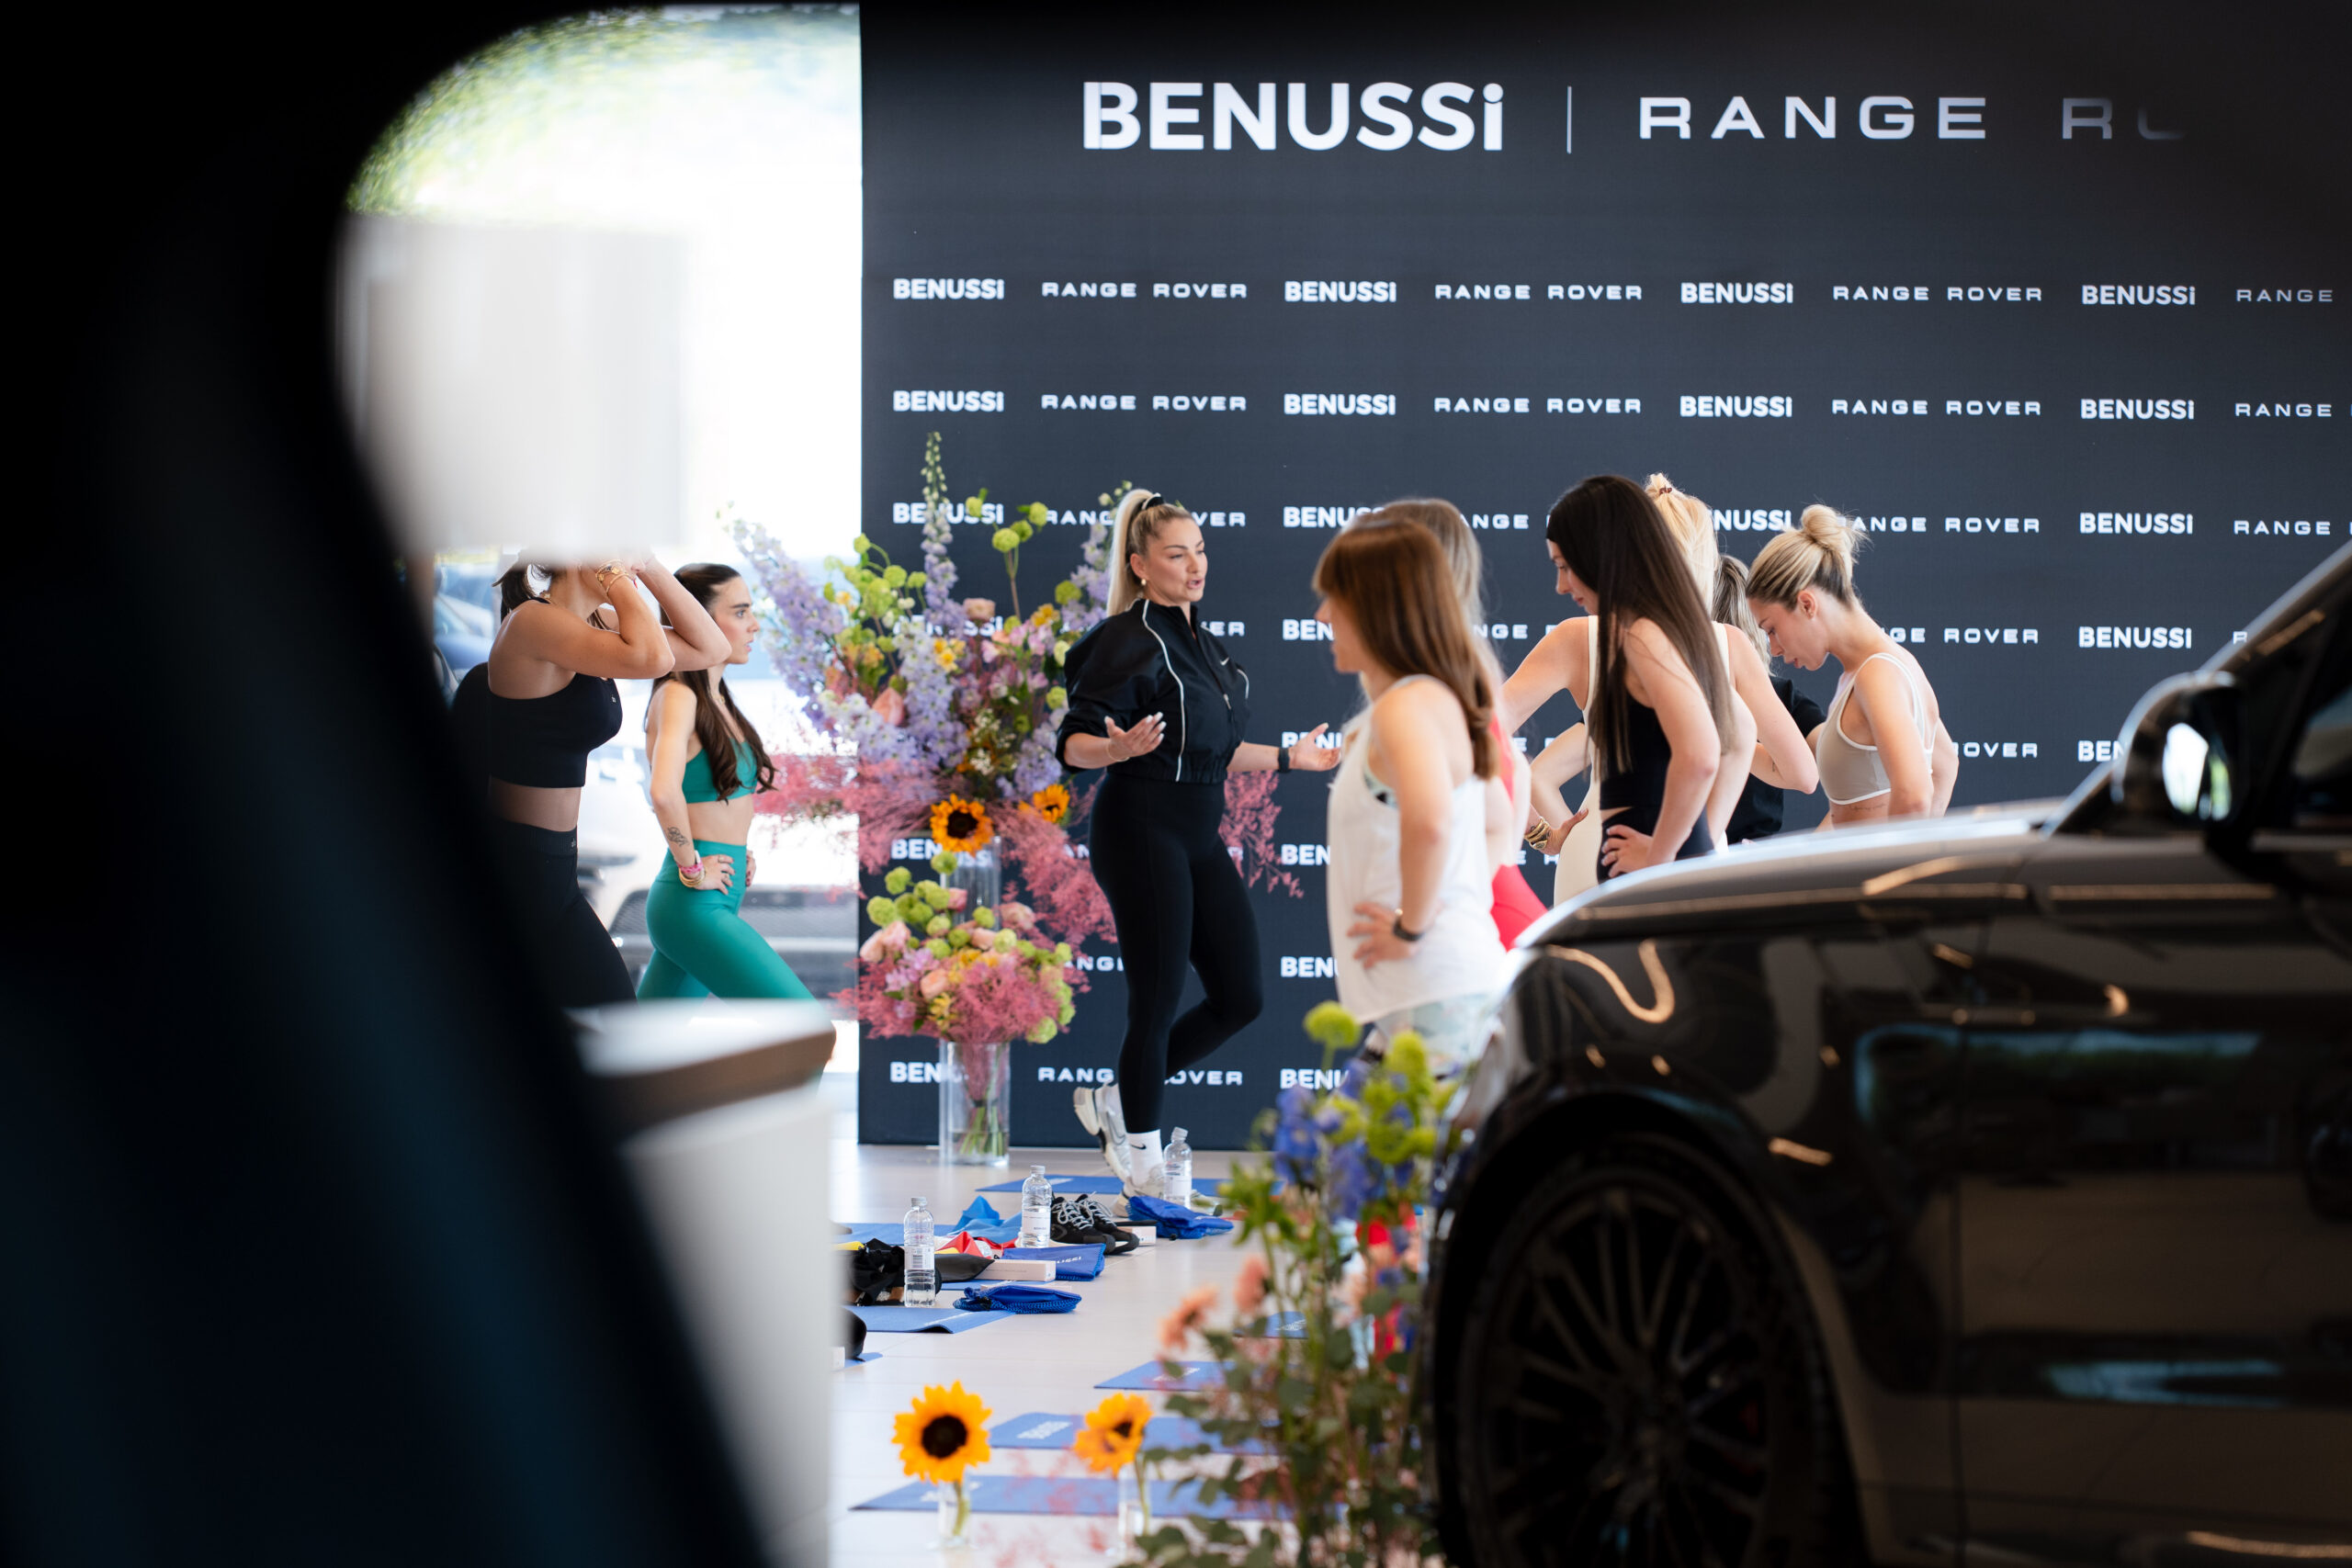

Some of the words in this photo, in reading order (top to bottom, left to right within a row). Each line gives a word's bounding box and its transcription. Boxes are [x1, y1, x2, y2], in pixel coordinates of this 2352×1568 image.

[1639, 96, 1986, 140] RANGE
[1042, 282, 1136, 298] RANGE
[1153, 283, 1247, 299] ROVER
[1435, 284, 1531, 299] RANGE
[1547, 285, 1642, 300] ROVER
[1833, 286, 1929, 301] RANGE
[1947, 287, 2042, 301] ROVER
[2236, 288, 2333, 302] RANGE
[1041, 394, 1136, 411] RANGE
[1152, 395, 1247, 412] ROVER
[1434, 397, 1530, 413] RANGE
[1546, 398, 1641, 413] ROVER
[1832, 399, 1928, 415] RANGE
[1946, 400, 2041, 415] ROVER
[2235, 402, 2332, 417] RANGE
[1192, 512, 1246, 529] VER
[1459, 513, 1529, 530] NGE
[1945, 517, 2040, 533] ROVER
[2233, 520, 2331, 536] RANGE
[1944, 627, 2039, 644] ROVER
[1037, 1066, 1115, 1084] RANG
[1167, 1069, 1243, 1087] OVER
